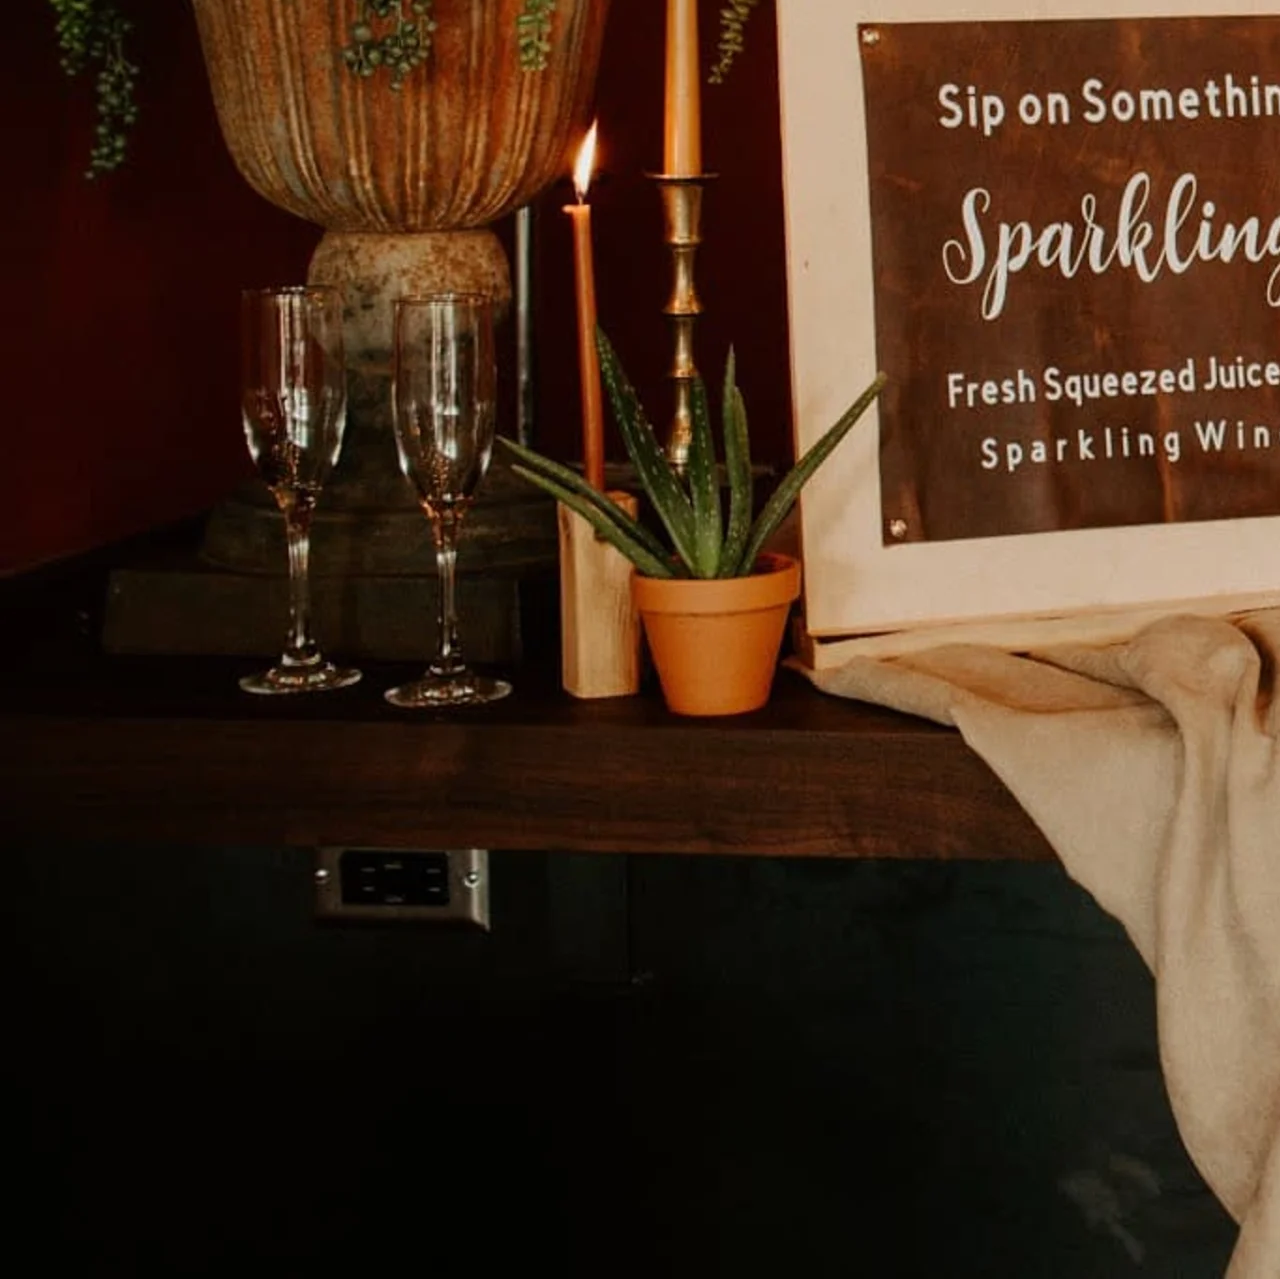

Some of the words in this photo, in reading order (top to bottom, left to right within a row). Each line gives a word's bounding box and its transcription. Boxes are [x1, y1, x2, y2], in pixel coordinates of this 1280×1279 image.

[939, 83, 1005, 136] Sip
[1018, 93, 1070, 125] on
[948, 369, 1036, 408] Fresh
[1044, 358, 1195, 406] Squeezed
[981, 427, 1180, 472] Sparkling
